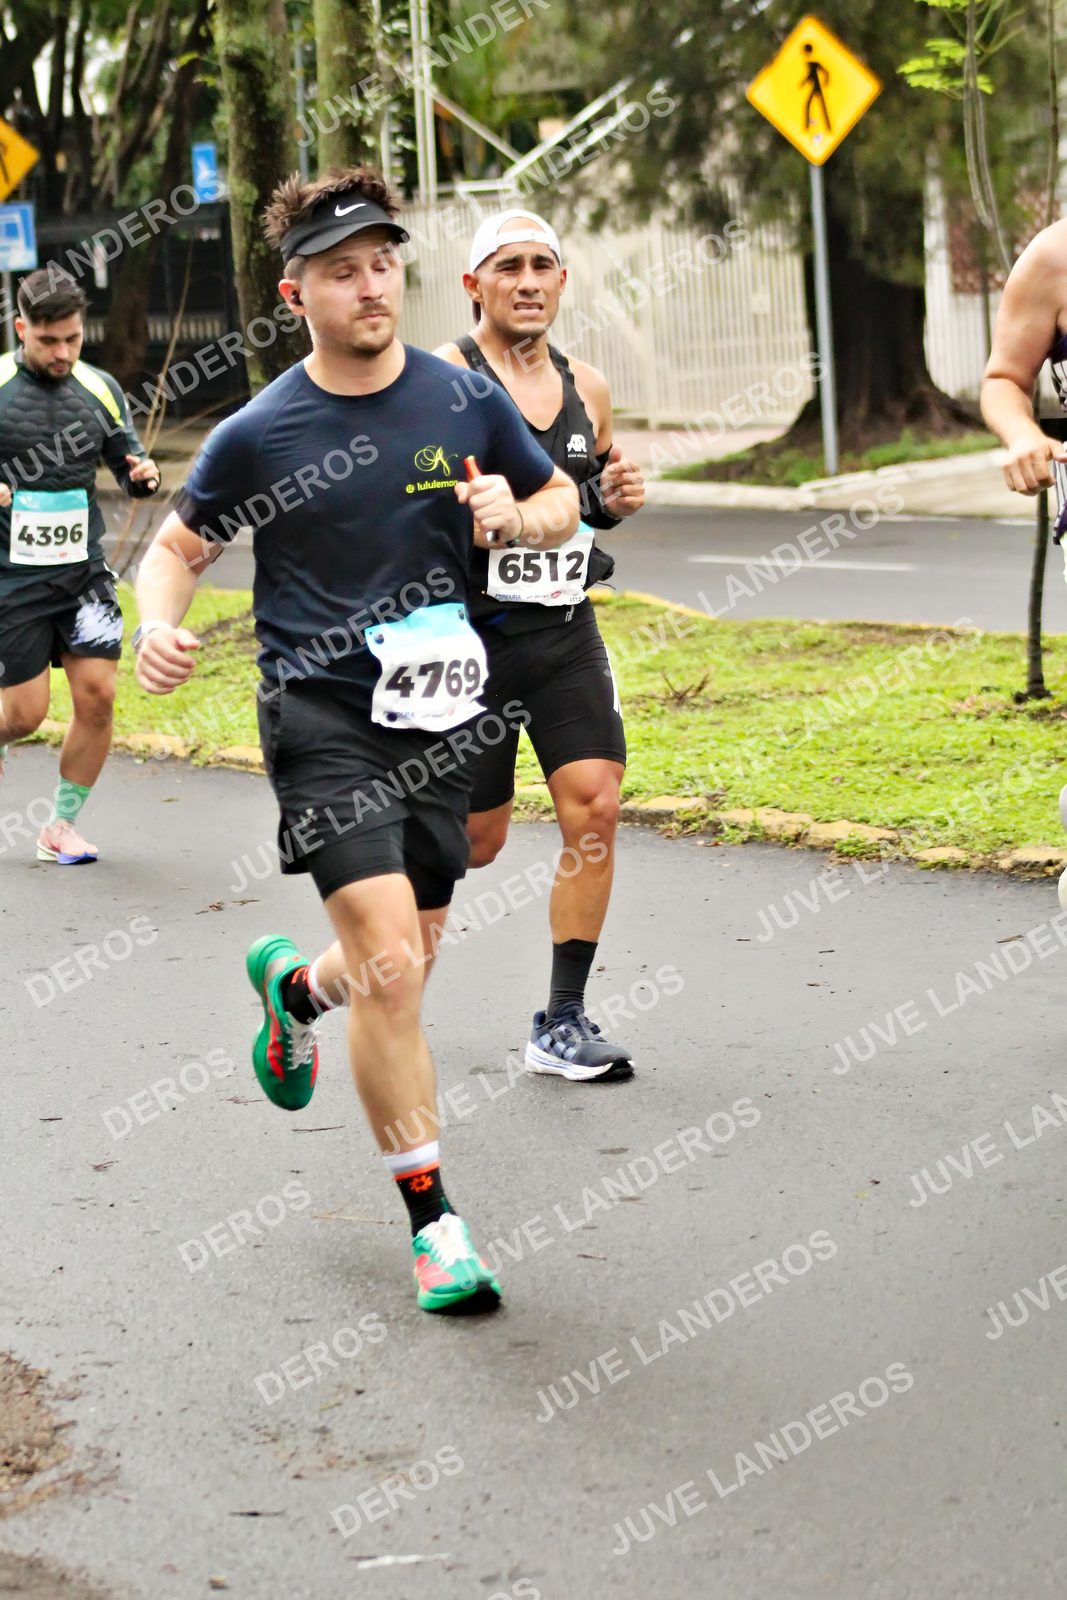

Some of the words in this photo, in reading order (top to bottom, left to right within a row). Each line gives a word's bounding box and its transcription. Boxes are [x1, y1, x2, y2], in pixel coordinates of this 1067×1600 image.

[417, 480, 458, 491] lululemon
[18, 523, 83, 547] 4396
[498, 550, 585, 584] 6512
[385, 658, 480, 698] 4769
